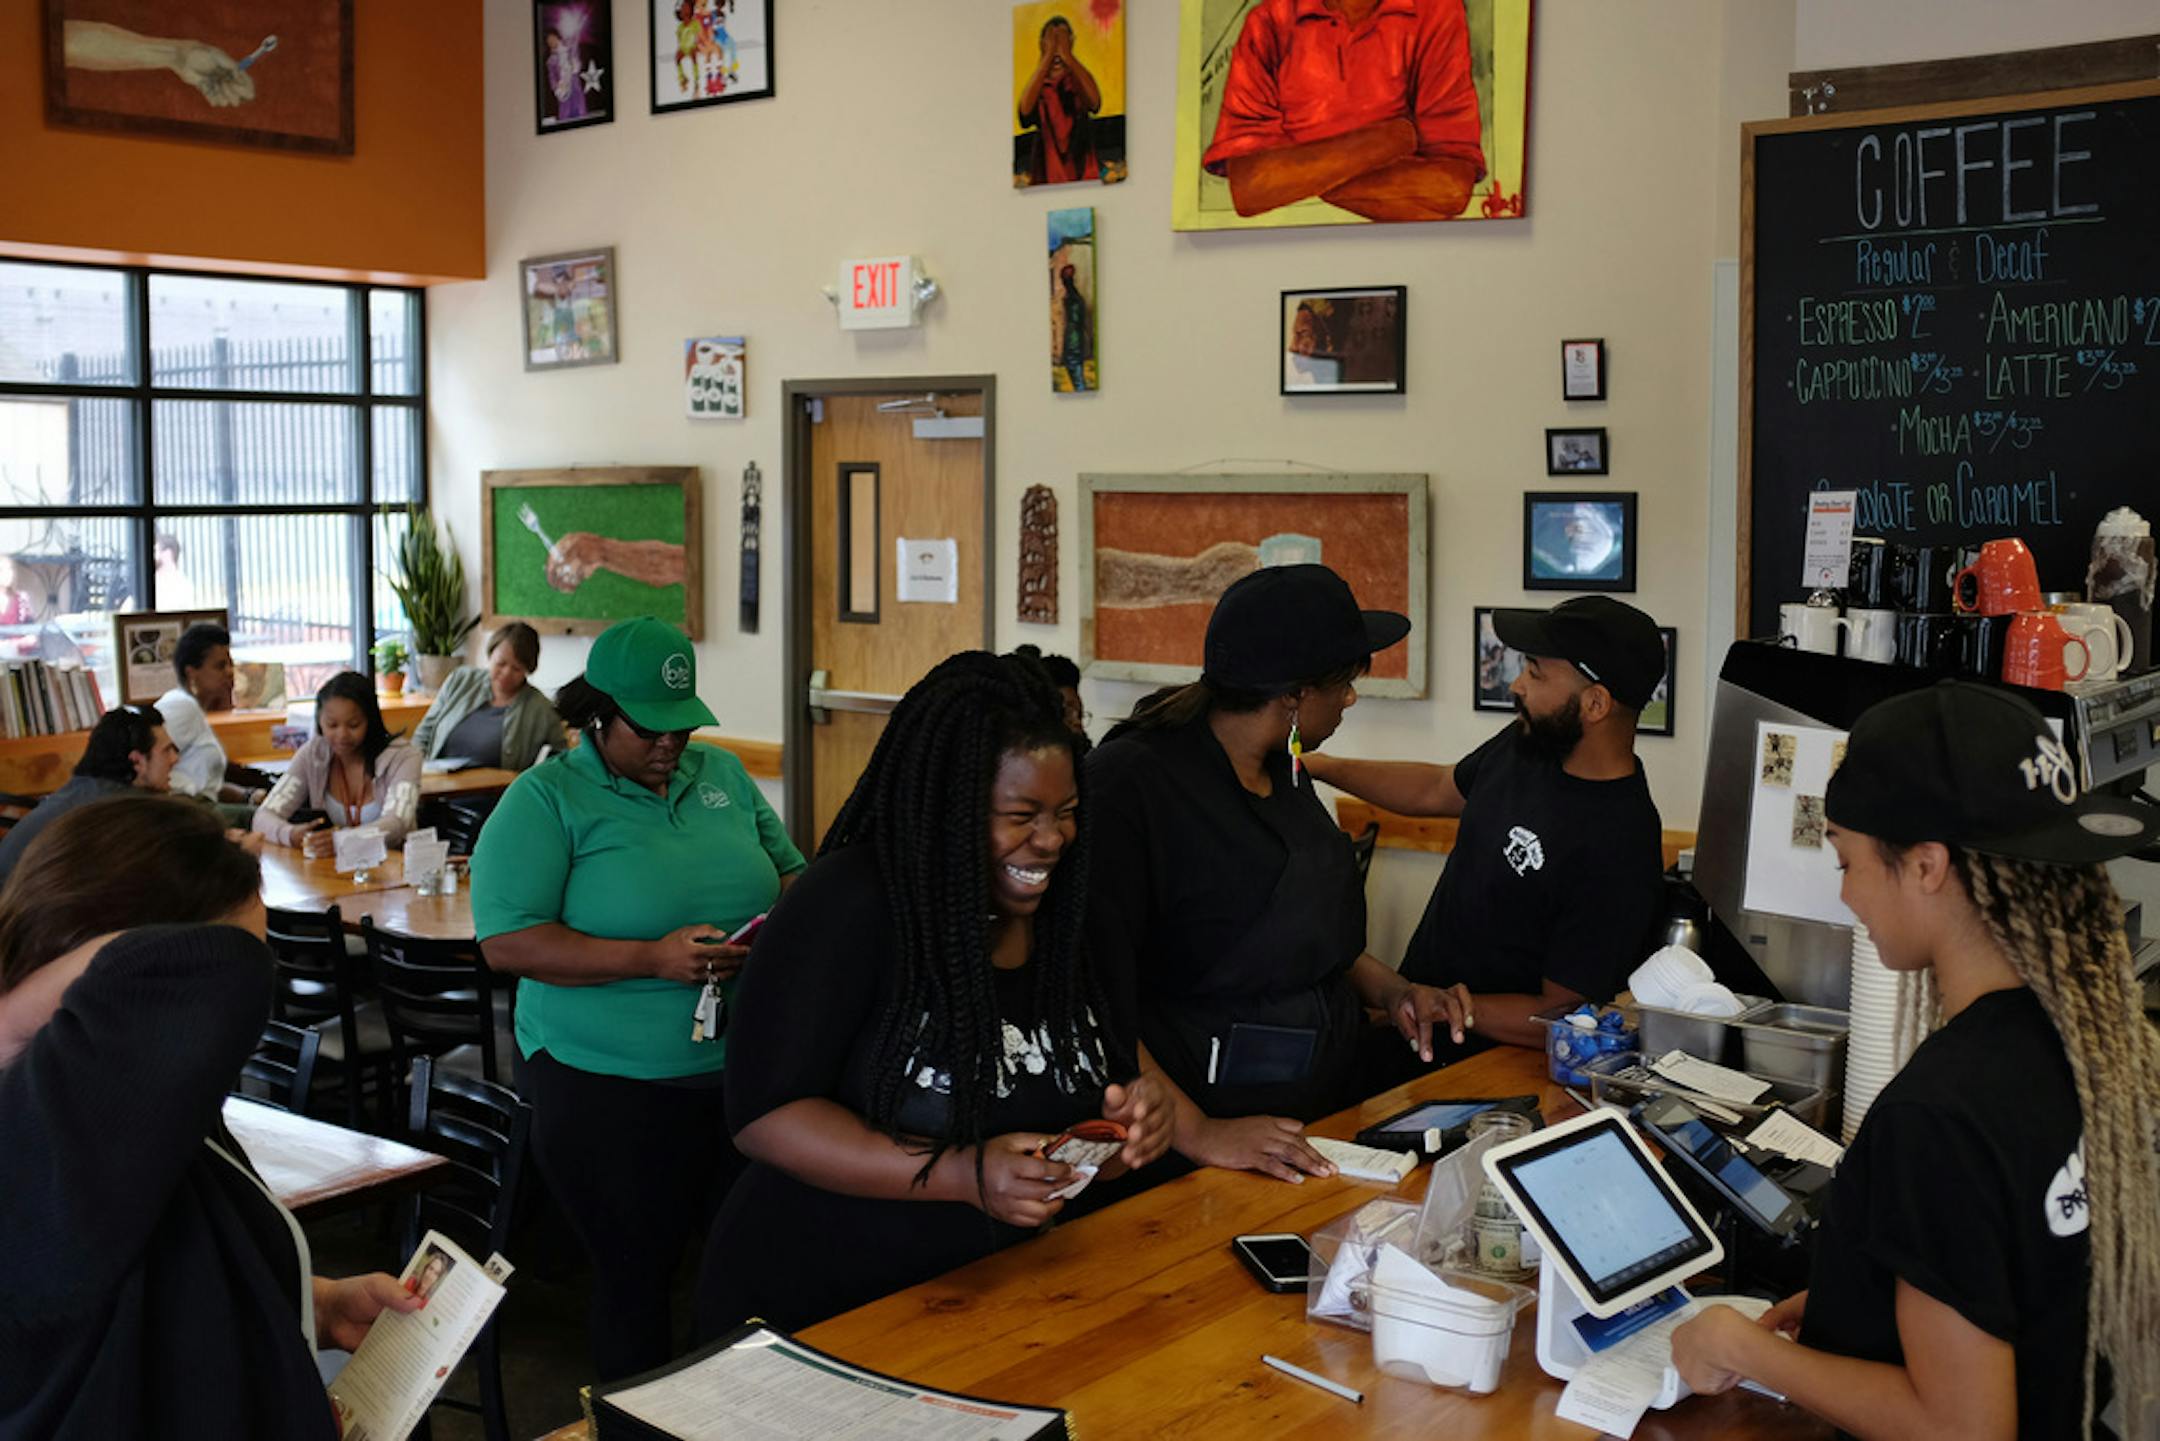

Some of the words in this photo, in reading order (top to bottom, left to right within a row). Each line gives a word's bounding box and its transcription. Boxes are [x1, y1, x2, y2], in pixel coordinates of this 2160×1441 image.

[1856, 111, 2099, 230] COFFEE
[1856, 238, 1936, 287] Regular
[1975, 228, 2050, 285] Decaf
[853, 262, 901, 309] EXIT
[1798, 296, 1898, 346] ESPRESSO
[1985, 290, 2130, 348] AMERICANO
[1795, 354, 1914, 405] CAPPUCCINO
[1985, 351, 2073, 401] LATTE
[1898, 404, 1973, 455] MOCHA
